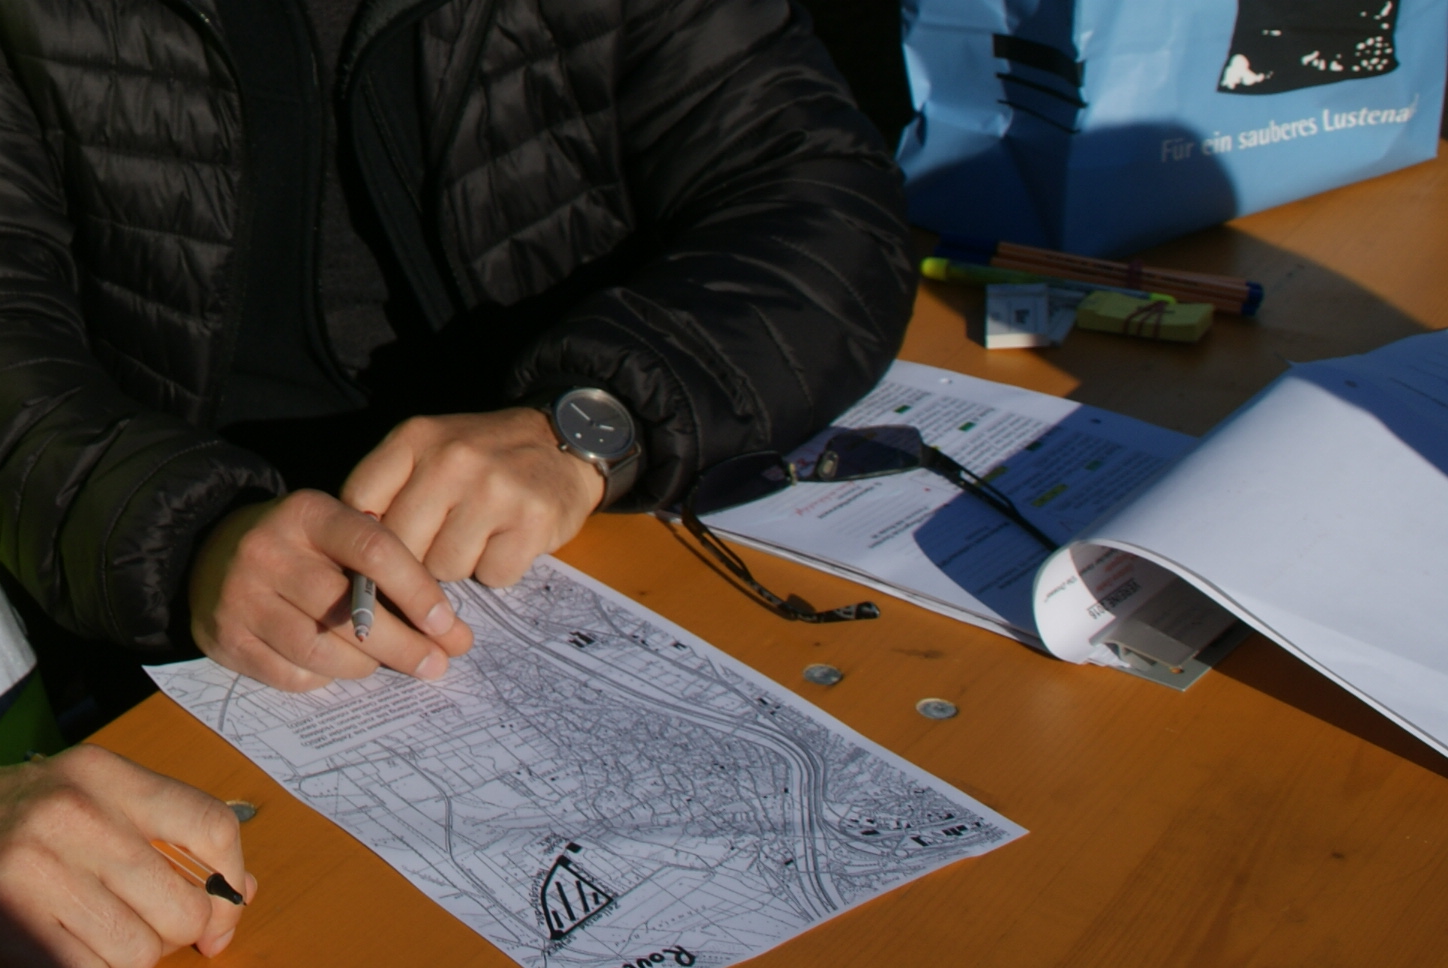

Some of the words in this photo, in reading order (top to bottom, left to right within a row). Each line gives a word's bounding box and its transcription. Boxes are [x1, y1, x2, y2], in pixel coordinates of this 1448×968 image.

[1161, 138, 1194, 163] Für
[1204, 132, 1232, 155] ein
[1238, 117, 1318, 148] sauberes
[1087, 598, 1111, 620] 2016
